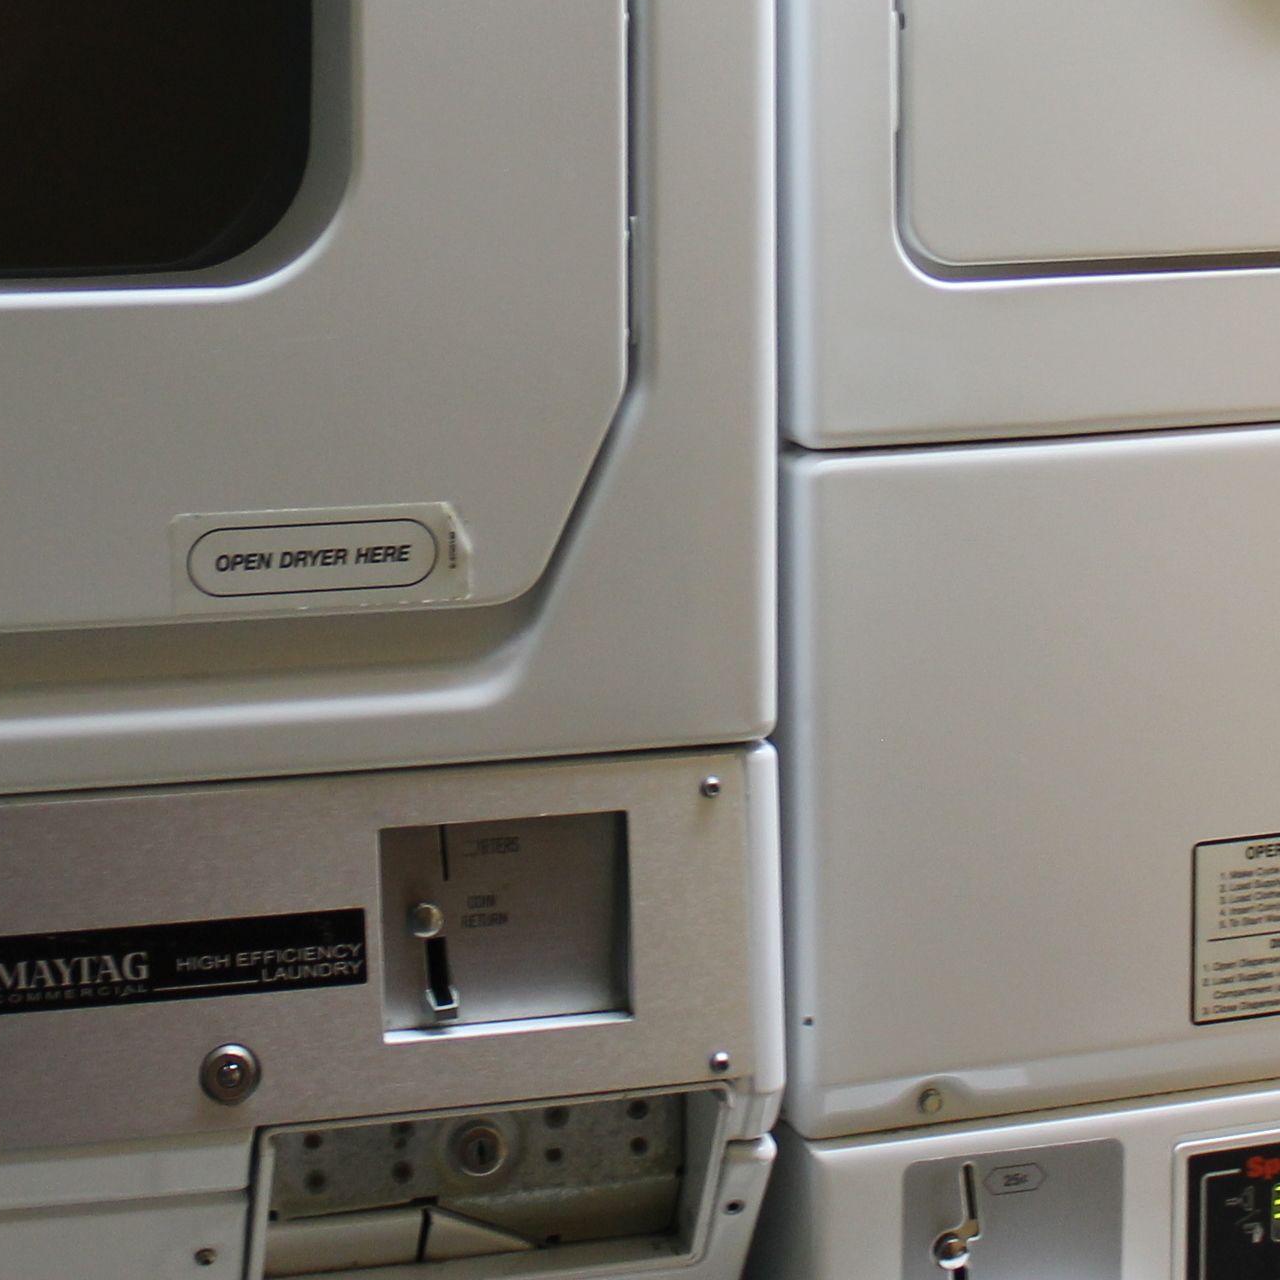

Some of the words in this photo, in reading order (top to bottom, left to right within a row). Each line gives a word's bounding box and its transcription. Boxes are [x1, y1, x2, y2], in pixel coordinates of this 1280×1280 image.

[215, 552, 273, 572] OPEN
[279, 548, 348, 569] DRYER
[354, 544, 413, 565] HERE
[175, 951, 232, 974] HIGH
[235, 942, 362, 970] EFFICIENCY
[260, 958, 363, 983] LAUNDRY
